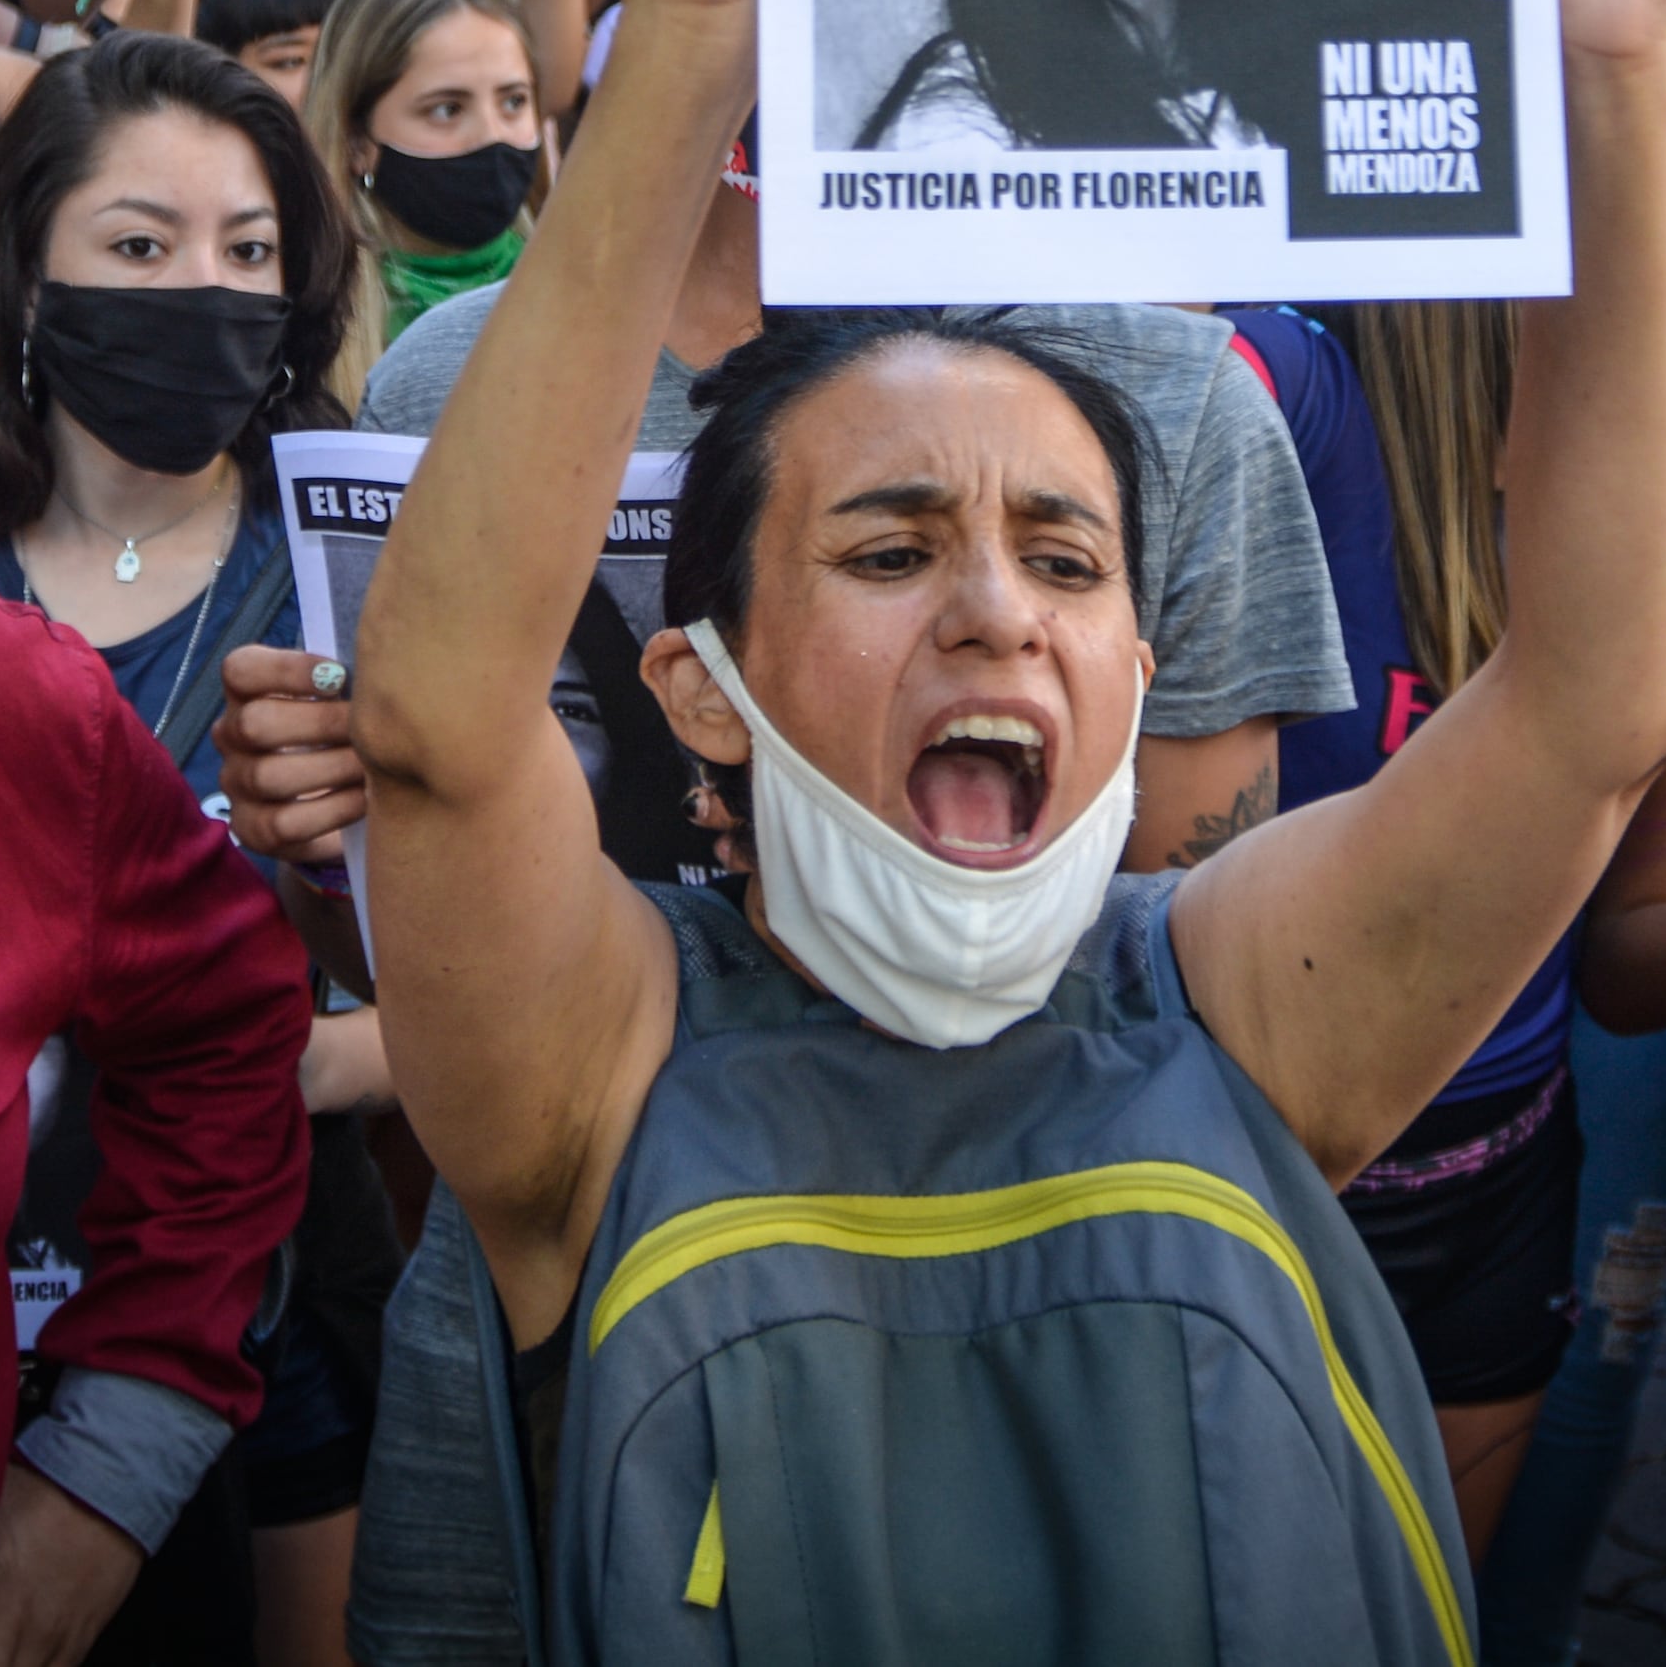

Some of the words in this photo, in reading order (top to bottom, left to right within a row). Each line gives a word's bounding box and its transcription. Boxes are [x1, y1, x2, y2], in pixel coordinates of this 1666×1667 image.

[1321, 40, 1374, 96] NI
[1379, 39, 1475, 96] UNA
[1325, 97, 1481, 153] MENOS
[819, 170, 981, 212] JUSTICIA
[991, 171, 1063, 212] POR
[1072, 171, 1266, 212] FLORENCIA
[1327, 152, 1481, 197] MENDOZA
[307, 485, 345, 519] EL
[14, 1281, 68, 1303] ENCIA
